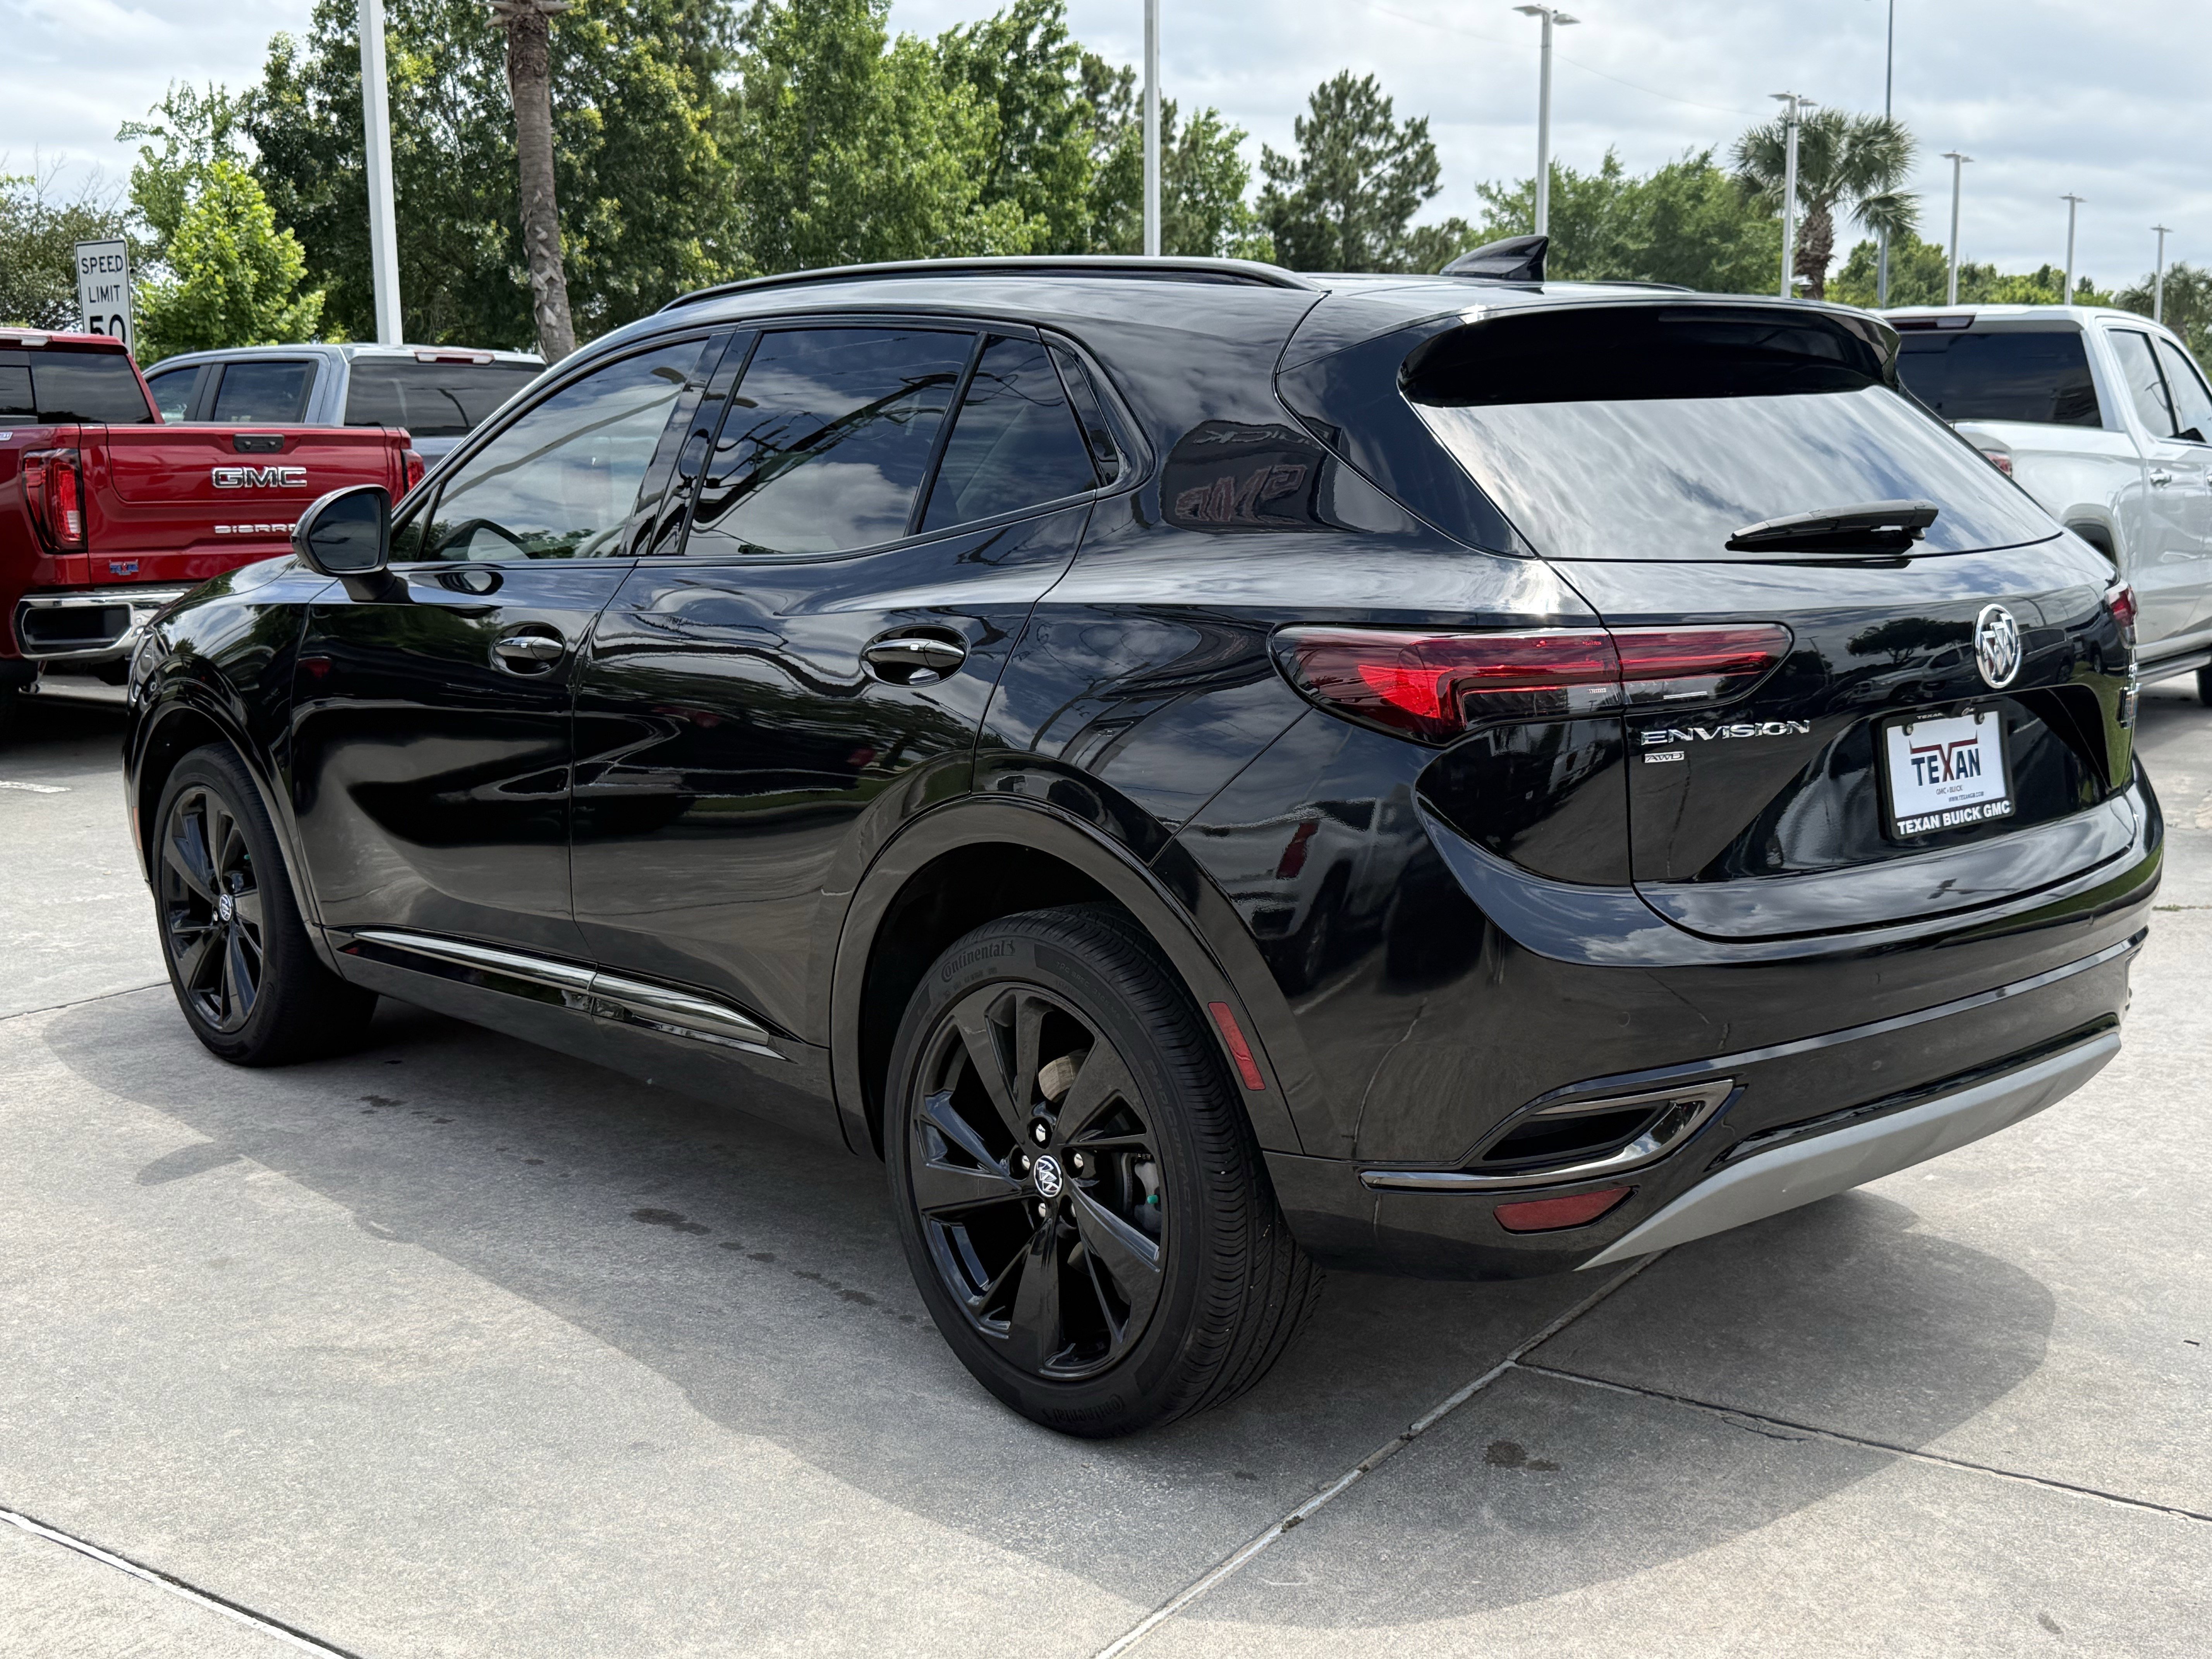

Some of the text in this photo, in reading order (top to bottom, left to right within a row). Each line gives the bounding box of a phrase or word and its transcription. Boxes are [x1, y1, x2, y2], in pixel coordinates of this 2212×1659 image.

[81, 255, 124, 274] SPEED
[88, 285, 120, 303] LIMIT
[211, 466, 307, 489] GMC
[1641, 720, 1810, 745] ENVISION
[1645, 752, 1684, 762] AWD
[1909, 739, 1982, 786] TEXAN
[1897, 800, 2011, 835] TEXAN BUICK GMC
[941, 939, 1006, 983] Continental
